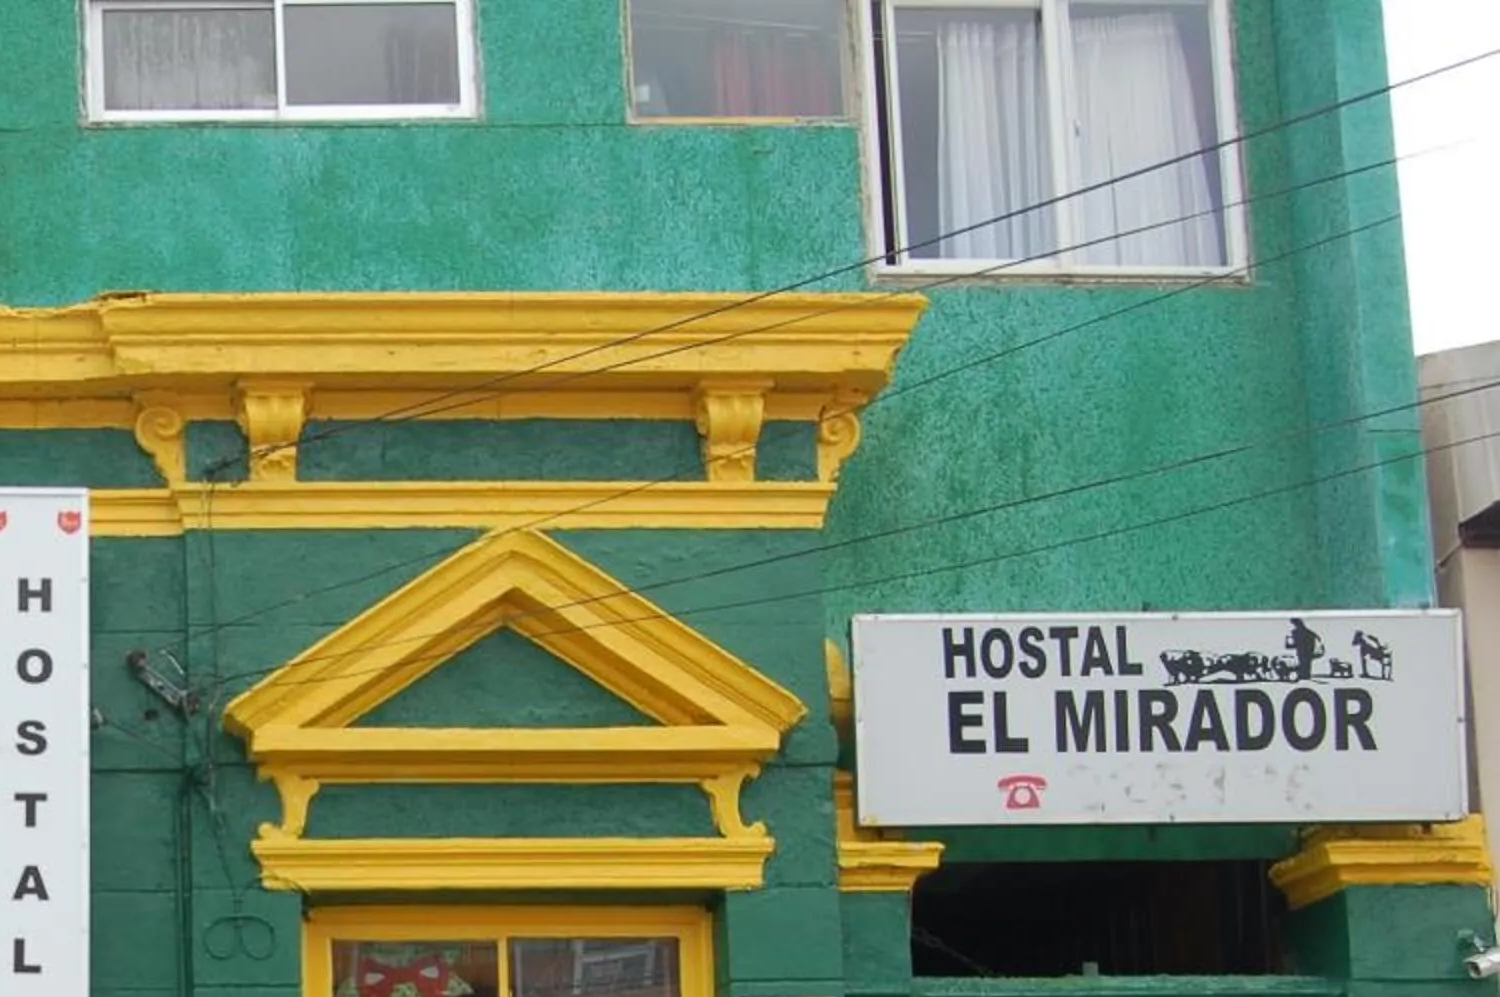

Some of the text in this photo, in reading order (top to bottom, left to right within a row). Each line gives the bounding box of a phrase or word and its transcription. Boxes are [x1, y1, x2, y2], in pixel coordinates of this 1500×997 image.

[943, 626, 1143, 679] HOSTAL
[948, 688, 1378, 754] EL MIRADOR
[12, 578, 55, 975] HOSTAL
